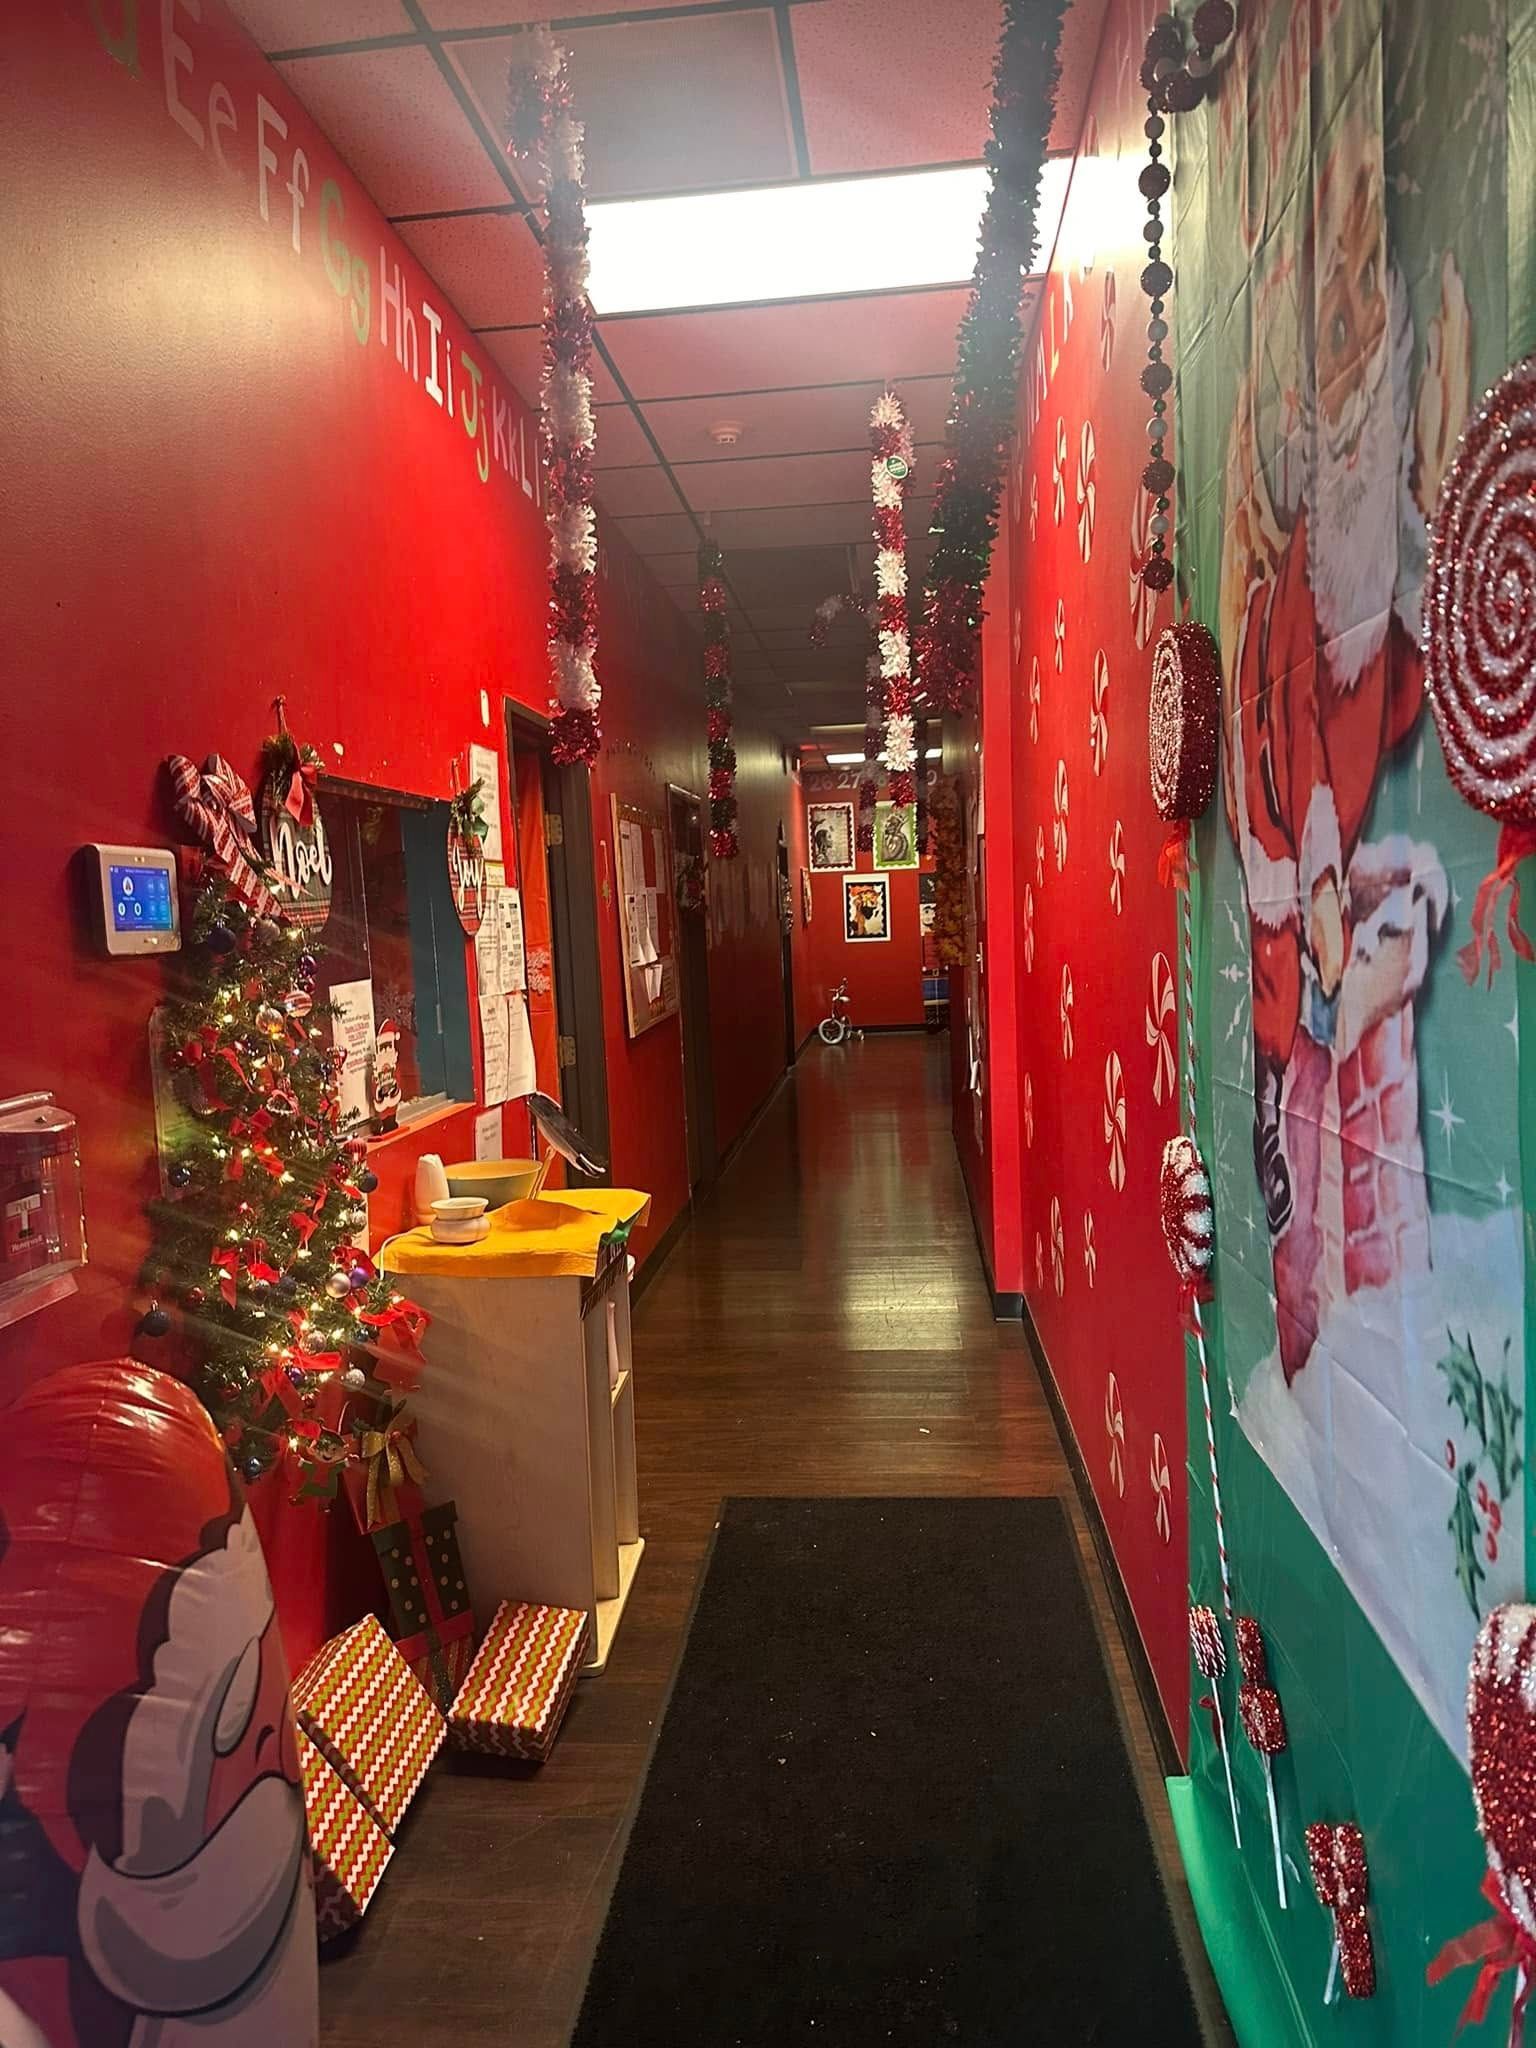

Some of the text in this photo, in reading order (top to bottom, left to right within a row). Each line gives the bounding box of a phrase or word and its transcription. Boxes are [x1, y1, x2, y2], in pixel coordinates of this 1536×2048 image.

[837, 772, 862, 789] 27
[270, 816, 332, 899] Noel
[452, 837, 485, 921] Joy
